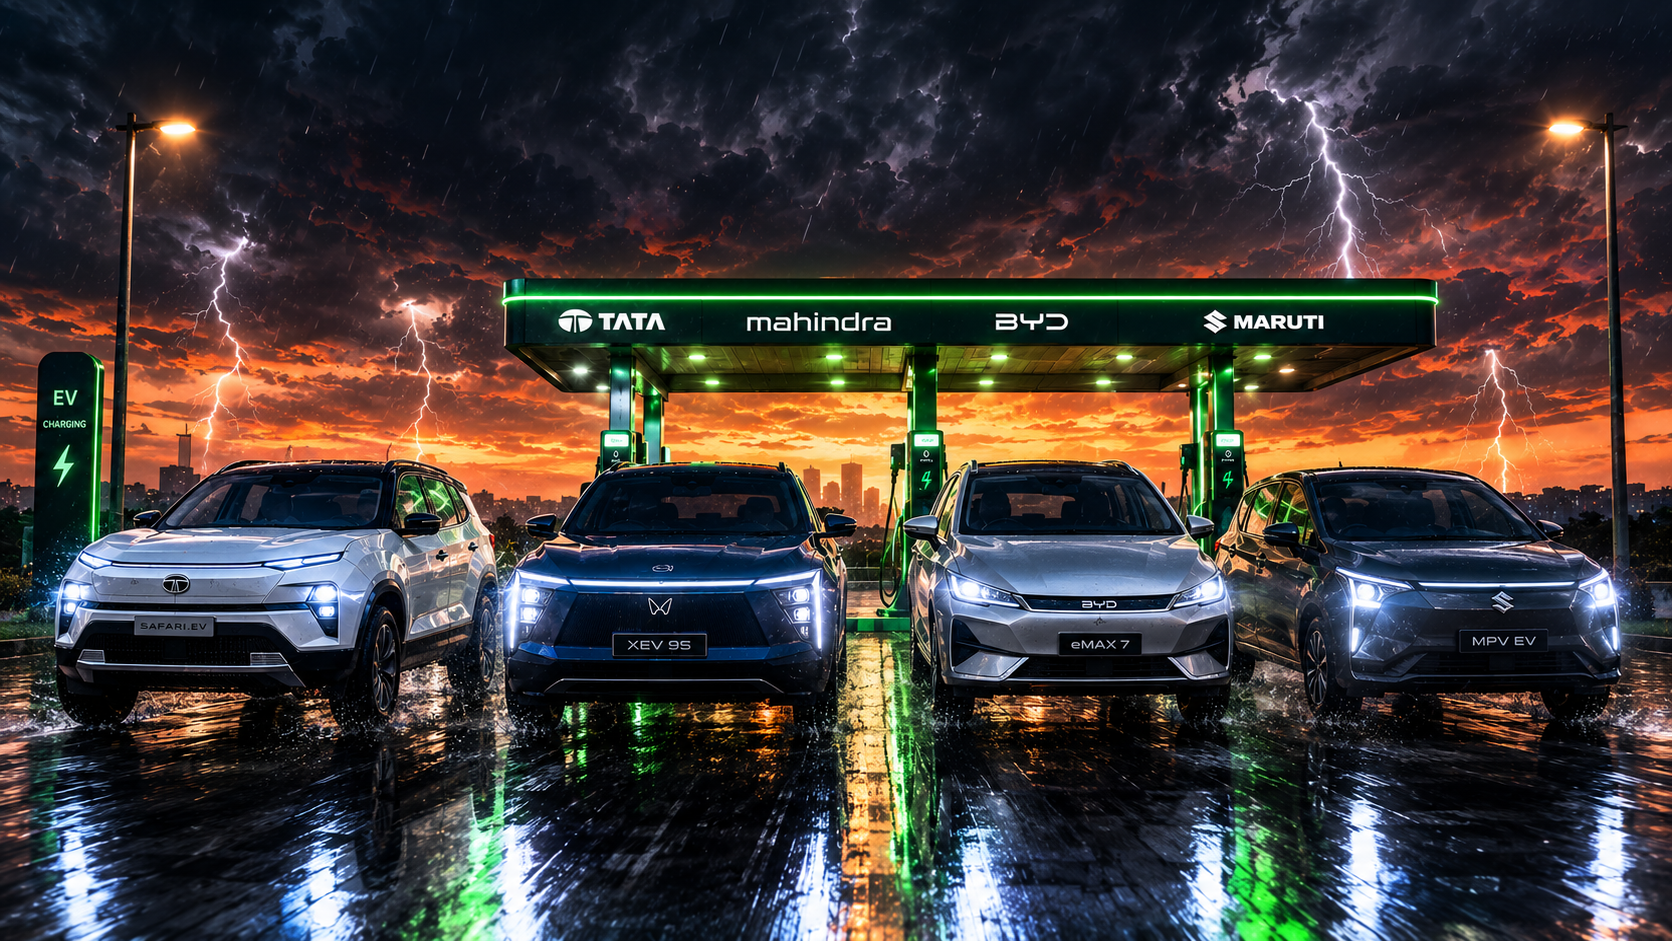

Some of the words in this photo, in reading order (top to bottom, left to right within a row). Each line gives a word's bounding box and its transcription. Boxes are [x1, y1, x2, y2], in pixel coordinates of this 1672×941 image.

[598, 313, 666, 331] TATA
[746, 311, 892, 332] mahindra
[995, 313, 1069, 331] BYD
[1233, 314, 1324, 330] MARUTI
[53, 389, 78, 406] EV
[42, 419, 87, 429] CHARGING
[1081, 600, 1118, 609] BYD
[140, 622, 207, 631] SAFARI.EV
[627, 640, 664, 651] XEV
[1070, 639, 1117, 650] eMAX
[1120, 639, 1130, 650] 7
[1472, 636, 1510, 646] MPV
[1514, 636, 1537, 646] EV
